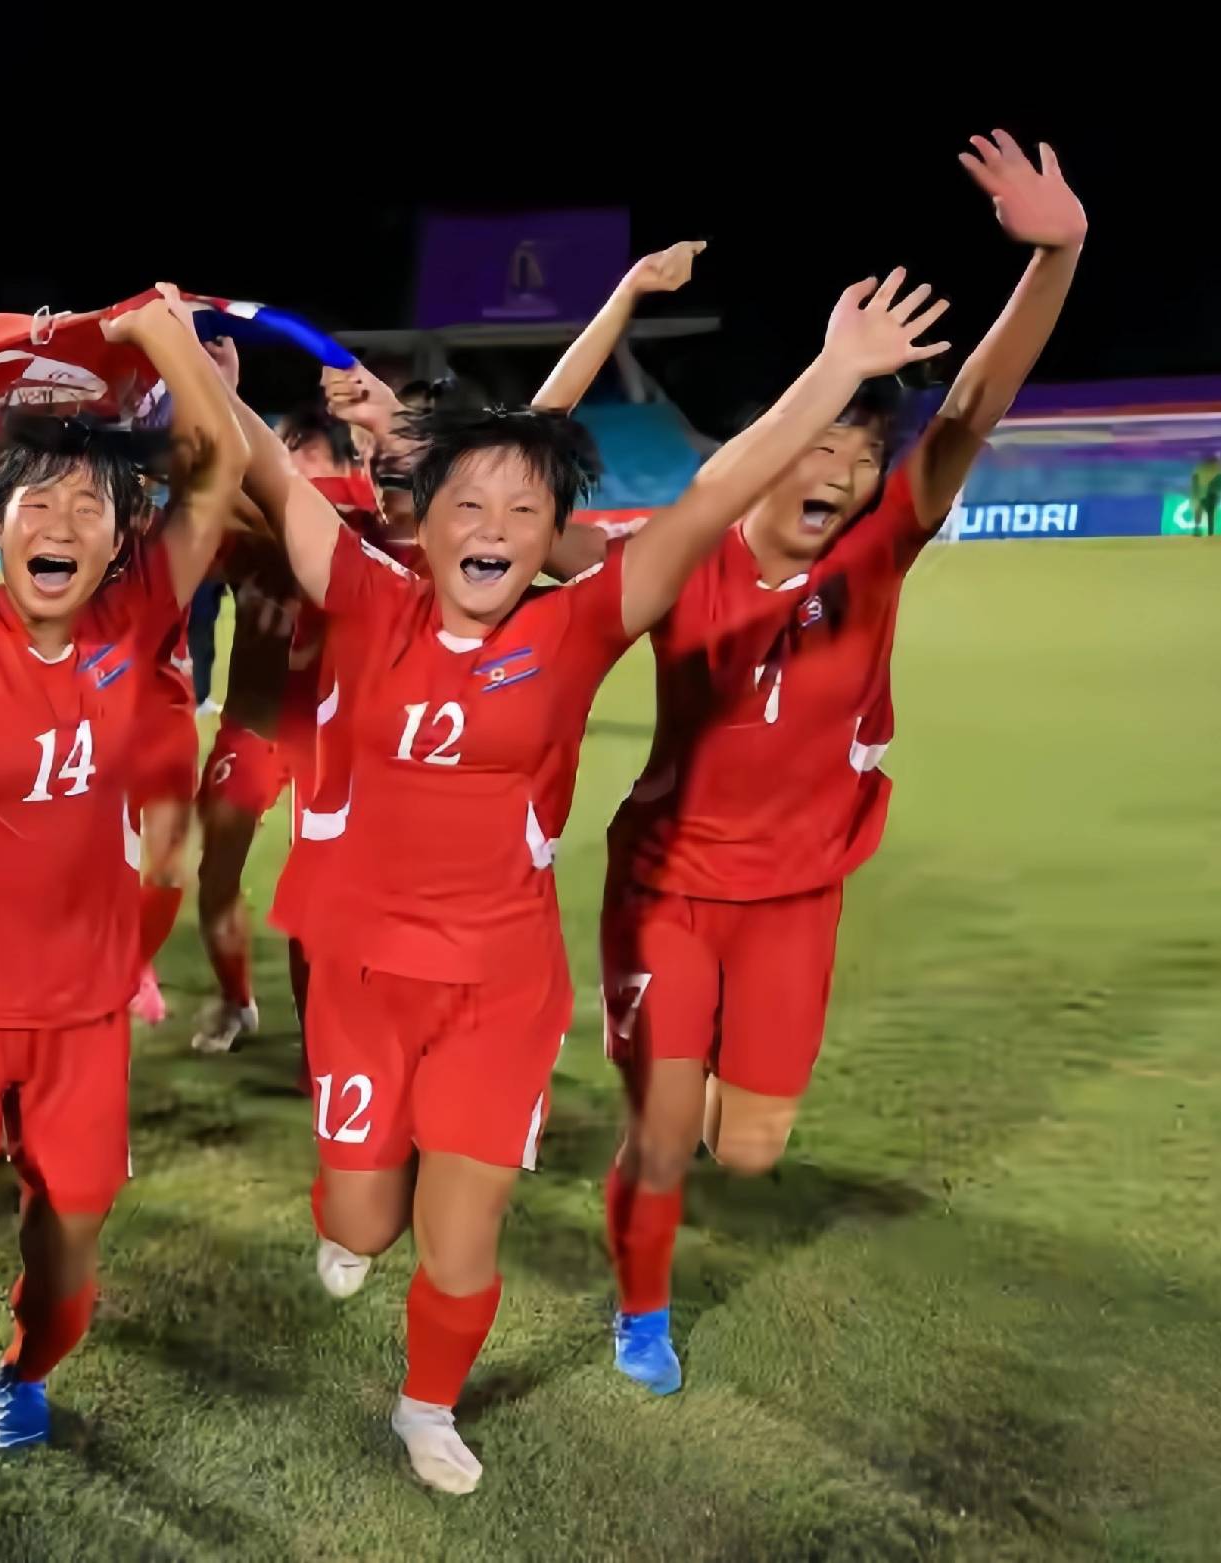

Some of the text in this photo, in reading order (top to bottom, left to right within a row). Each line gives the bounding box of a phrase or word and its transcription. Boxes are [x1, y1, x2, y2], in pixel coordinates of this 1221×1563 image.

[959, 503, 1078, 534] UNDAI
[21, 718, 97, 803] 14
[395, 700, 467, 767] 12
[619, 972, 653, 1040] 7
[314, 1072, 374, 1145] 12
